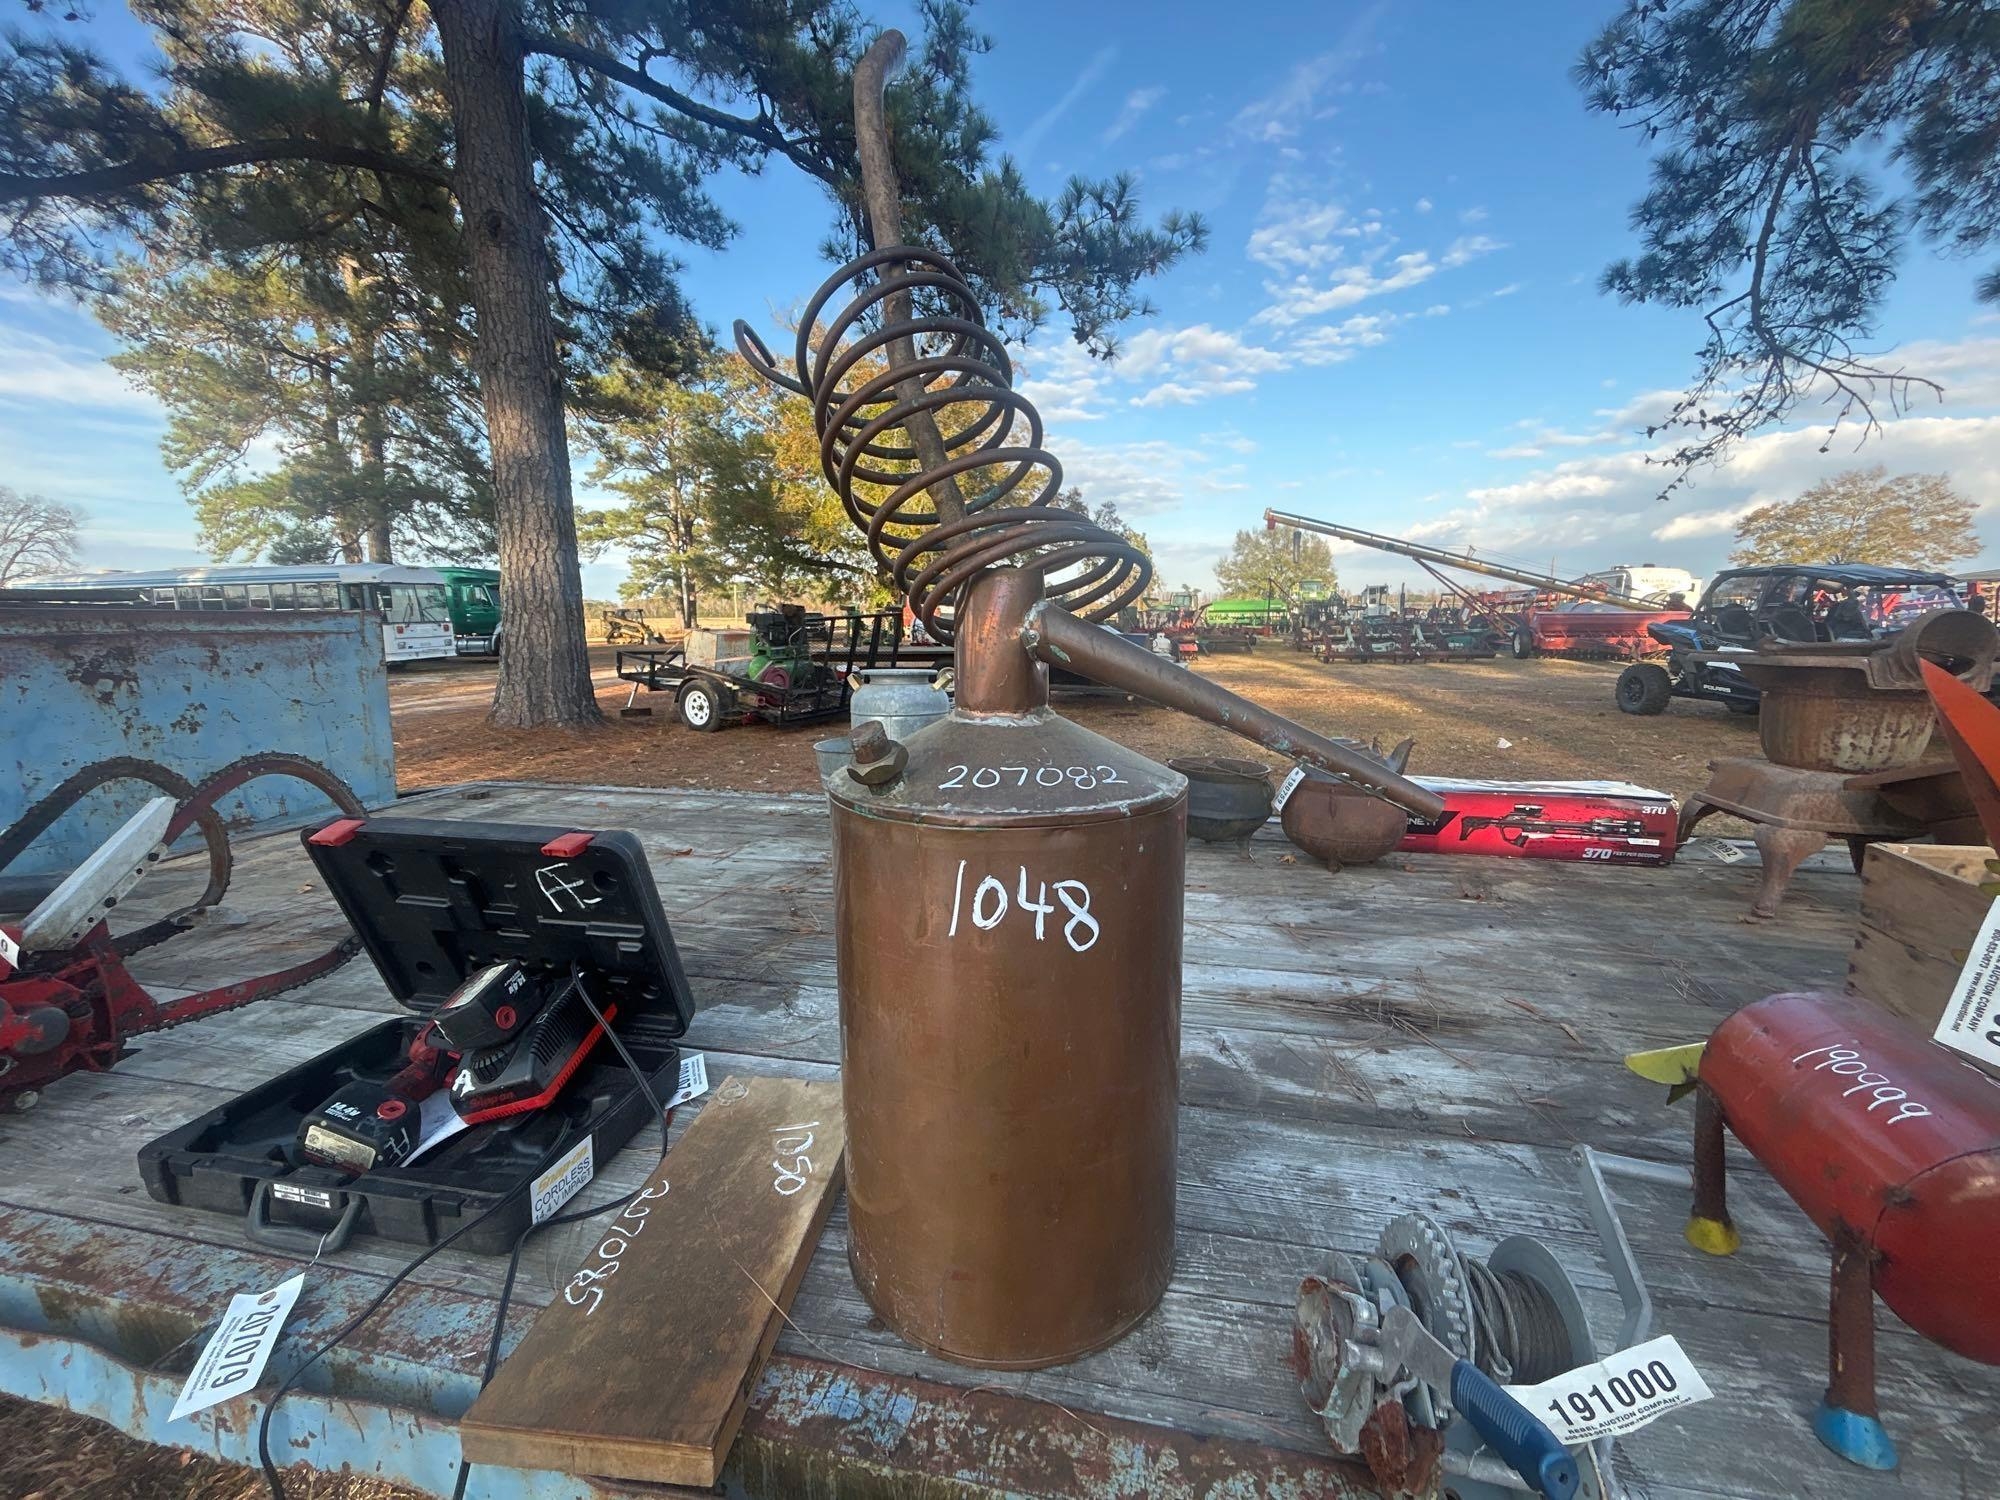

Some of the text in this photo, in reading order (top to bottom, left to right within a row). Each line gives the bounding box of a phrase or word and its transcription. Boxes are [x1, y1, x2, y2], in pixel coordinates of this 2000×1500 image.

[937, 763, 1128, 790] 207082
[1277, 777, 1297, 806] 190759
[1642, 806, 1667, 815] 370
[1582, 847, 1613, 860] 370
[947, 859, 1100, 953] 1048
[1966, 996, 1990, 1032] COMPANY
[452, 1069, 476, 1098] A
[1791, 1043, 1933, 1125] 190999
[769, 1120, 820, 1197] 1050
[534, 1156, 590, 1212] CORDLESS
[561, 1167, 592, 1199] IMPACT
[563, 1178, 670, 1317] 207085
[210, 1304, 281, 1389] 207079
[1548, 1360, 1678, 1427] 191000
[1567, 1395, 1682, 1435] REBEL AUCTION COMPANY
